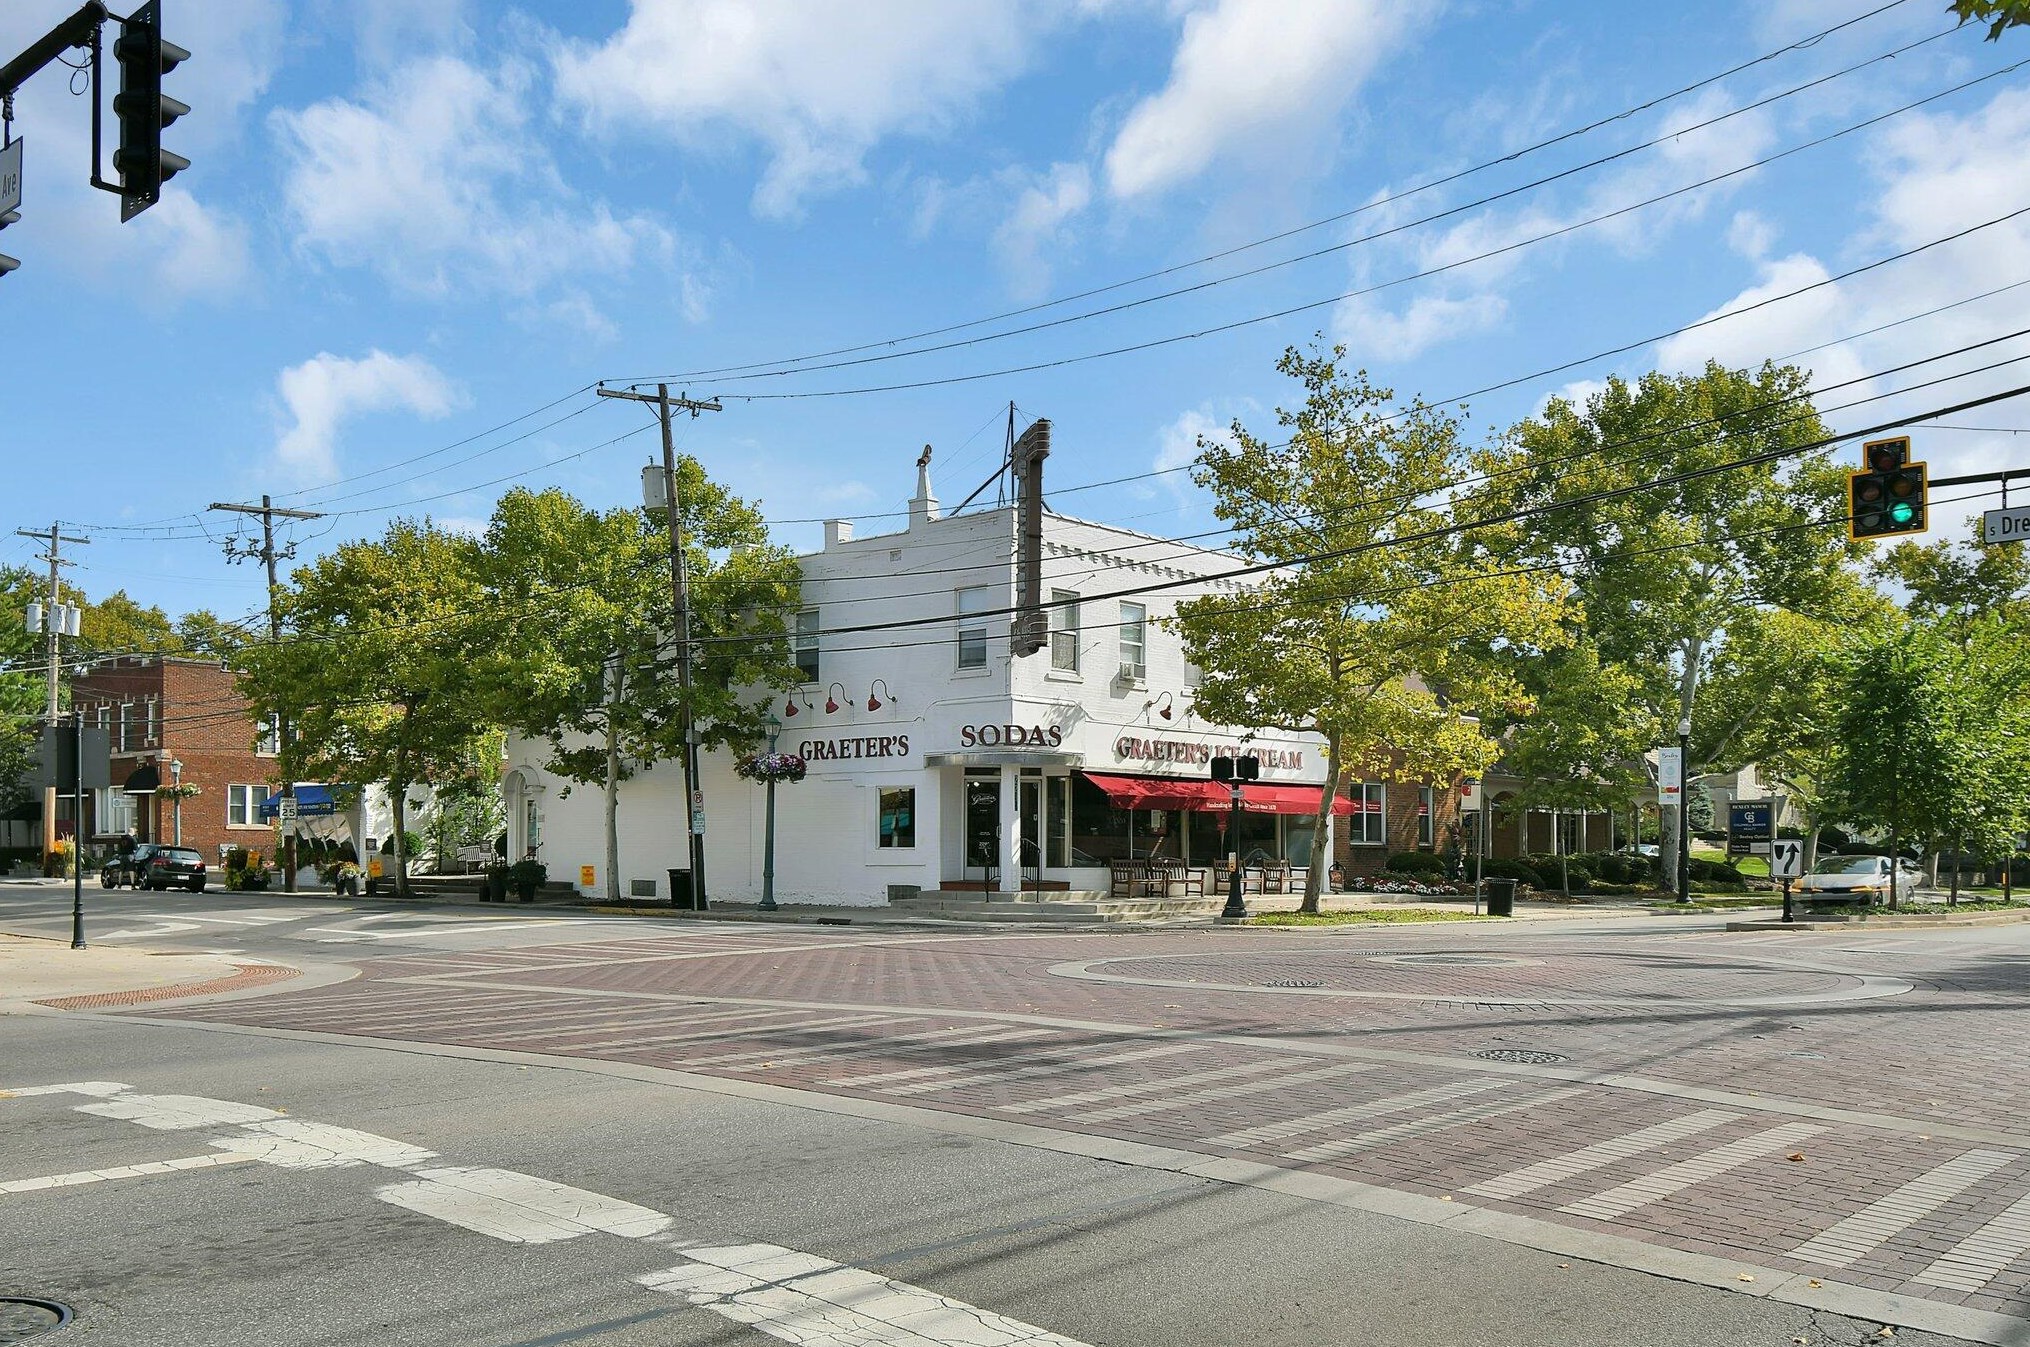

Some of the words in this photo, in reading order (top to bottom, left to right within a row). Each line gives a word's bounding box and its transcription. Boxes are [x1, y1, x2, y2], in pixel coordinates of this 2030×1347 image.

[2, 173, 17, 199] Ave
[2001, 516, 2030, 534] Dre
[799, 735, 909, 761] GRAETER'S
[961, 725, 1062, 748] SODAS
[1117, 736, 1210, 765] GRAETER'S
[281, 808, 296, 817] 25
